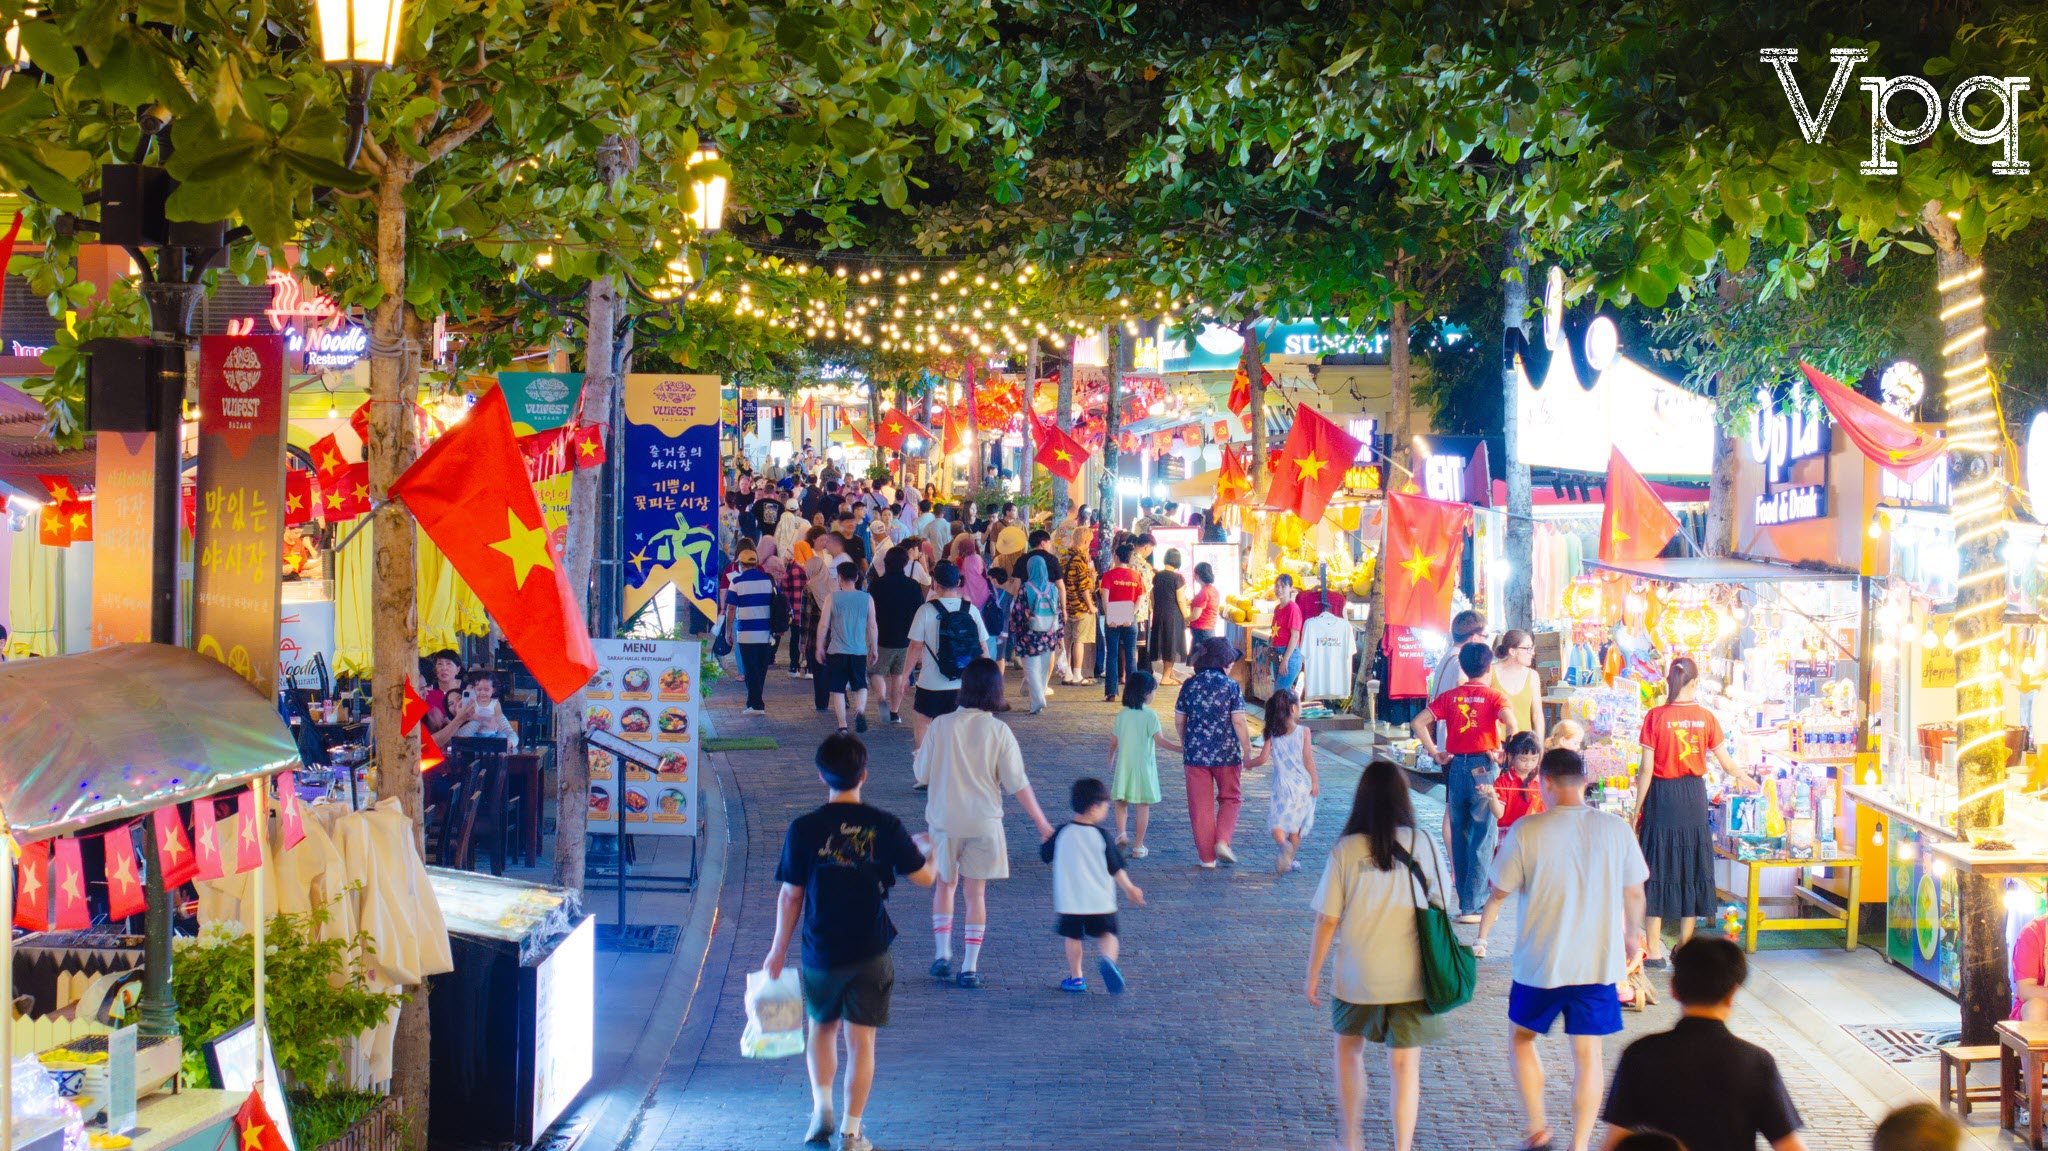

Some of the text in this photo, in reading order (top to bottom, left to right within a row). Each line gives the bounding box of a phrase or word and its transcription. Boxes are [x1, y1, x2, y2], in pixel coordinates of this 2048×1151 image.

[305, 327, 367, 351] Noodle
[525, 403, 569, 415] VUIFEST
[653, 405, 696, 416] VUIFEST
[649, 445, 702, 458] 즐거움의
[651, 459, 693, 472] 야시장
[652, 478, 695, 494] 기쁨이
[205, 485, 267, 533] 맛있는
[633, 495, 711, 512] 꽃피는 시장
[1755, 494, 1778, 524] Food
[1789, 486, 1817, 519] Drink
[201, 539, 268, 584] 야시장
[622, 642, 657, 654] MENU
[279, 677, 319, 687] Reurant
